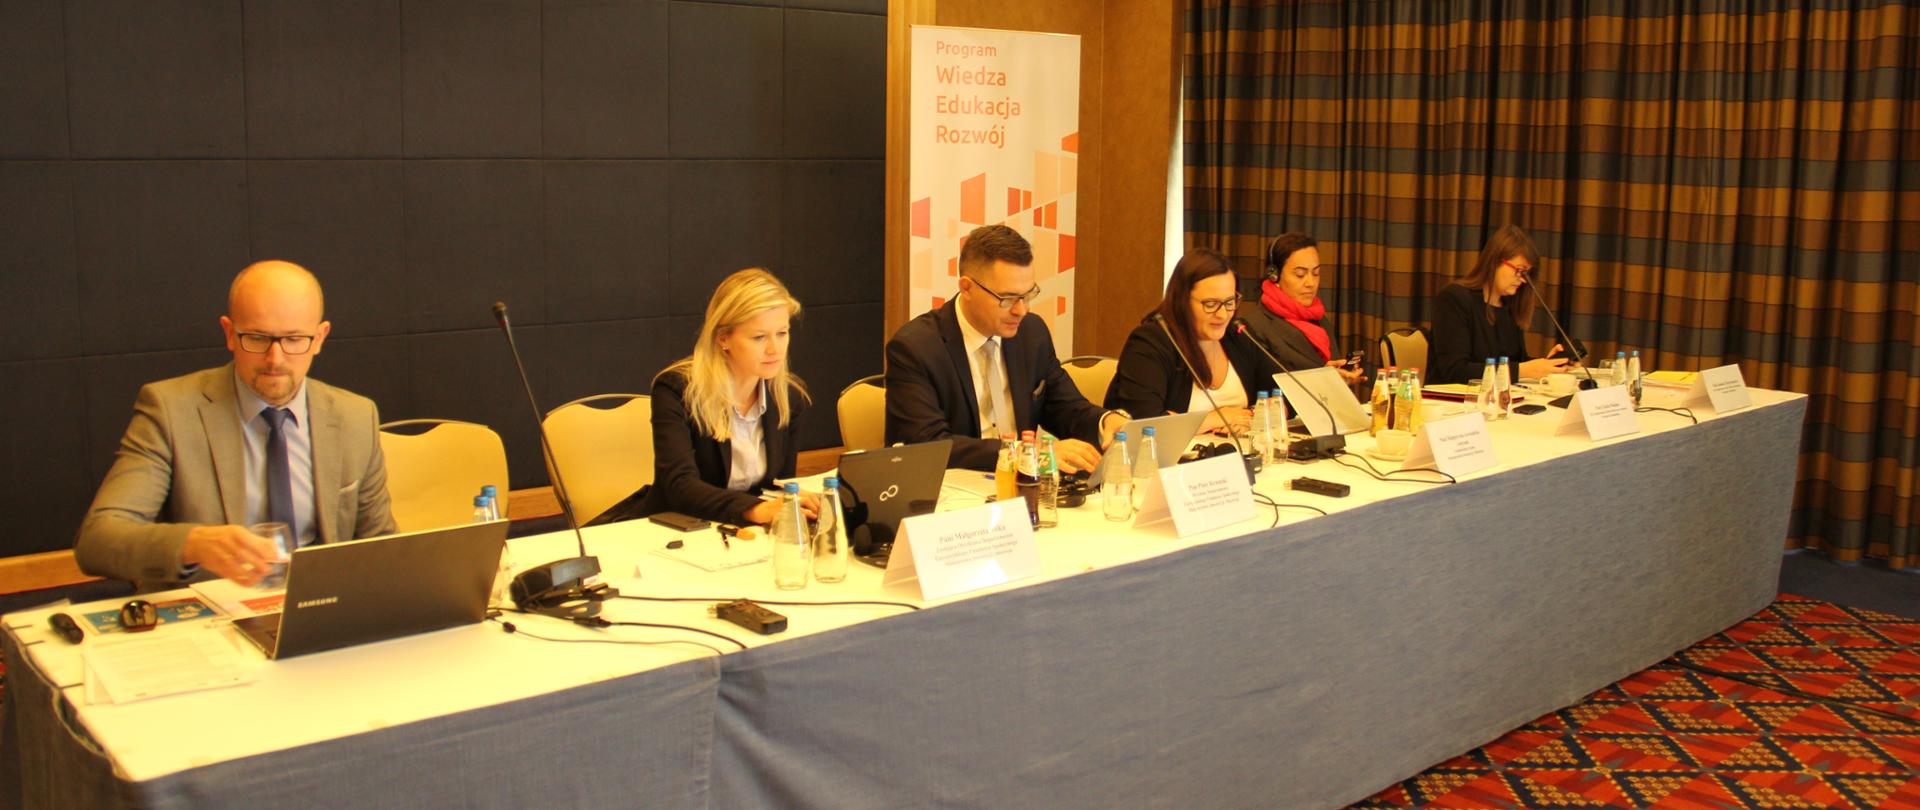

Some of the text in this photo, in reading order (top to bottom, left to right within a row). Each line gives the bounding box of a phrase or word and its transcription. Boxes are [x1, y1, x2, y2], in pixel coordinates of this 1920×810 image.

[936, 40, 997, 59] Program
[936, 65, 1007, 86] Wiedza
[936, 94, 1021, 120] Edukacja
[936, 124, 1006, 149] Rozwój
